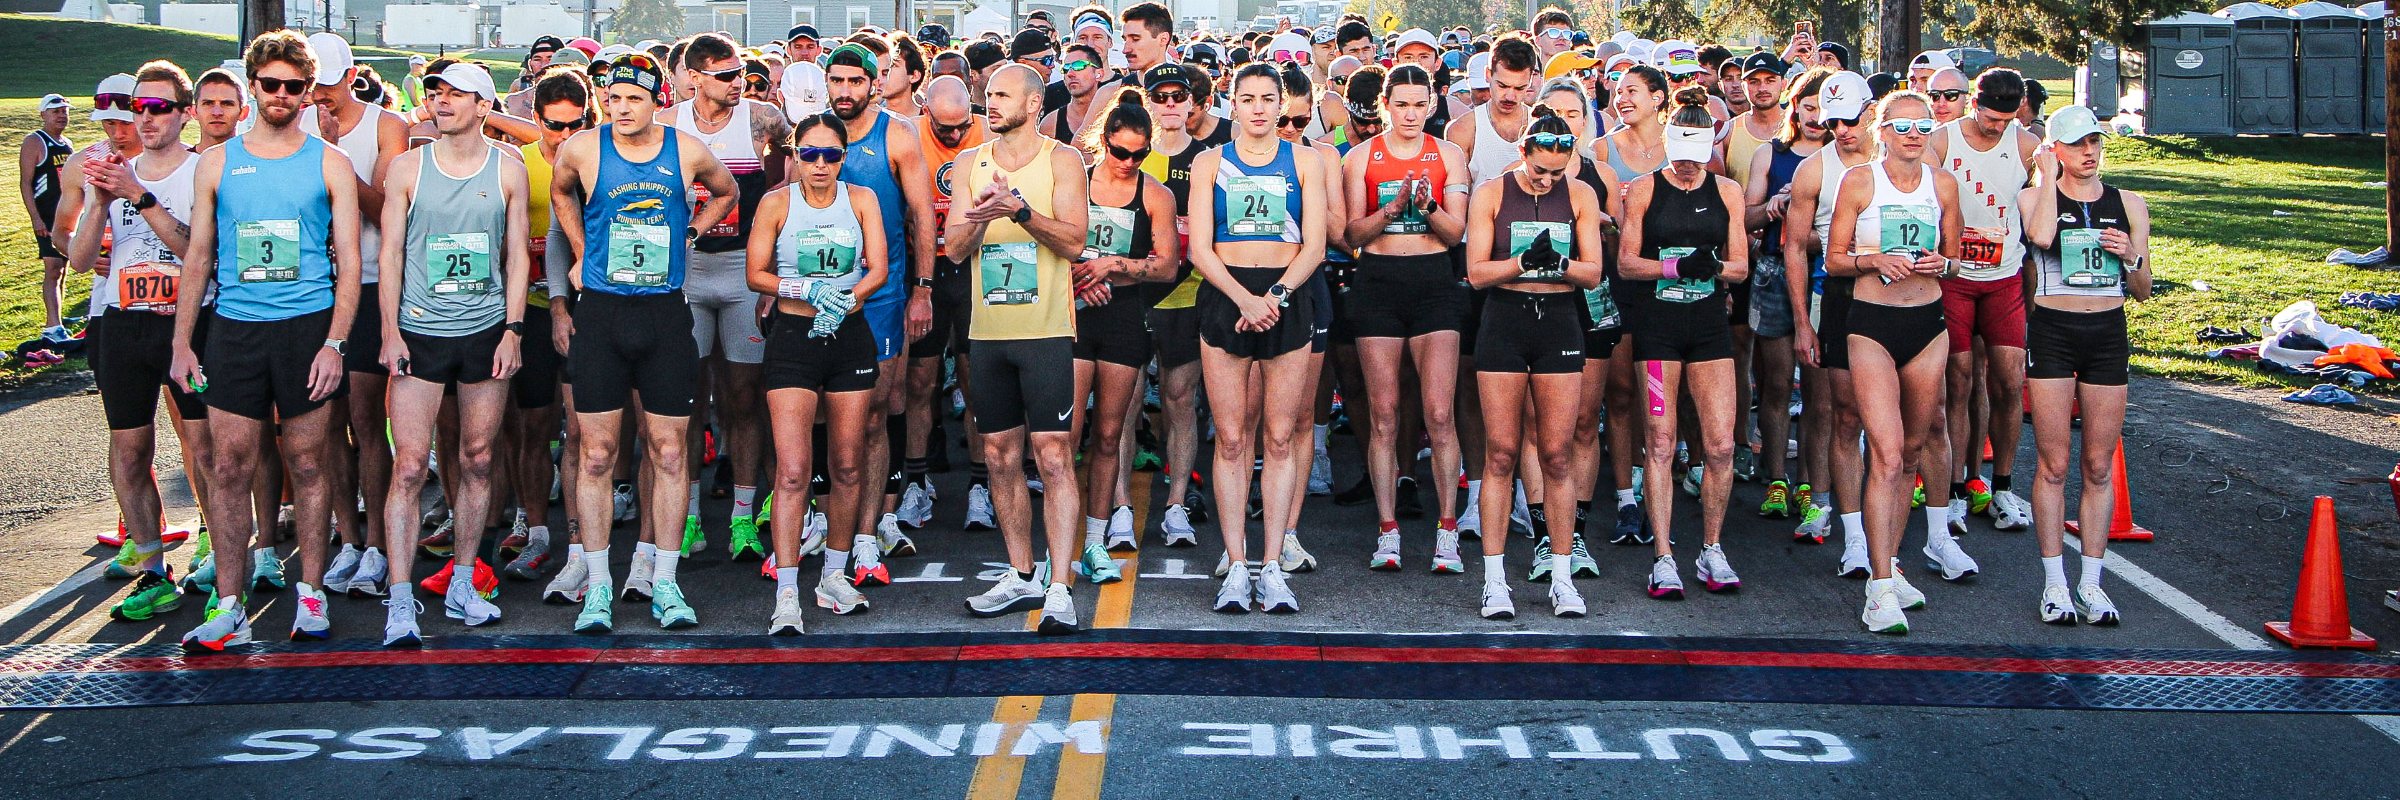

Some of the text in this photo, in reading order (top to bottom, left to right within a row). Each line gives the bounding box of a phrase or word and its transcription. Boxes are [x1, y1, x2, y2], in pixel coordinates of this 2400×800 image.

[231, 164, 257, 176] cahaba
[608, 182, 638, 199] DASHING
[639, 181, 673, 198] WHIPPETS
[1244, 194, 1269, 218] 24
[123, 217, 133, 226] In
[616, 213, 665, 225] RUNNING TEAM
[1094, 224, 1114, 247] 13
[1900, 223, 1920, 246] 12
[261, 240, 274, 264] 3
[632, 244, 645, 268] 5
[817, 248, 839, 270] 14
[1960, 240, 1997, 261] 1519
[2081, 247, 2103, 270] 18
[446, 253, 472, 277] 25
[1001, 263, 1013, 287] 7
[125, 275, 174, 300] 1870
[223, 719, 1854, 763] GUTHRIE WINEGLASS
